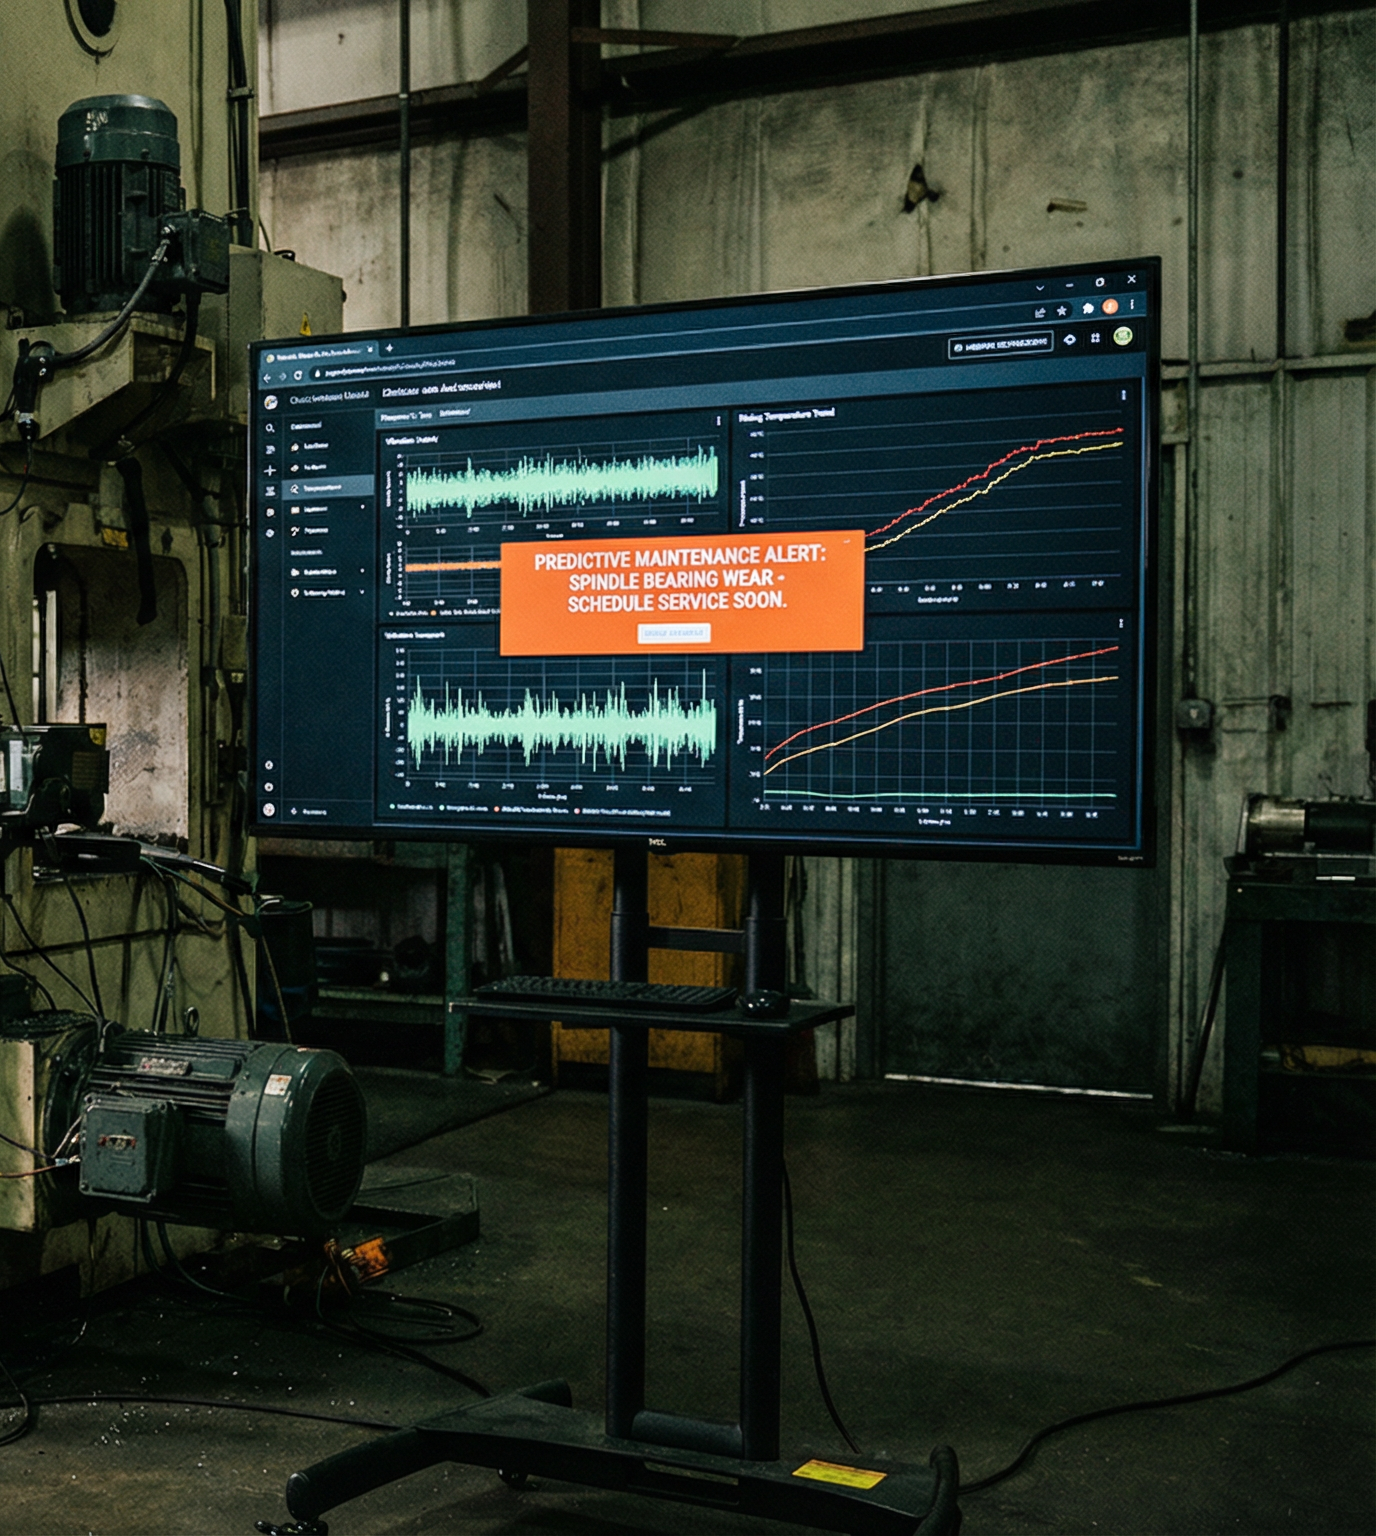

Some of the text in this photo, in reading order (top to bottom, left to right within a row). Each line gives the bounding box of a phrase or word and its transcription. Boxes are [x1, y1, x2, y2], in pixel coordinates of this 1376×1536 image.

[764, 410, 812, 422] Temperature
[534, 543, 827, 571] PREDICTIVE MAINTENANCE ALERT:
[569, 572, 640, 592] SPINDLE
[643, 569, 719, 590] BEARING
[723, 568, 774, 587] WEAR
[567, 590, 788, 613] SCHEDULE SERVICE SOON.
